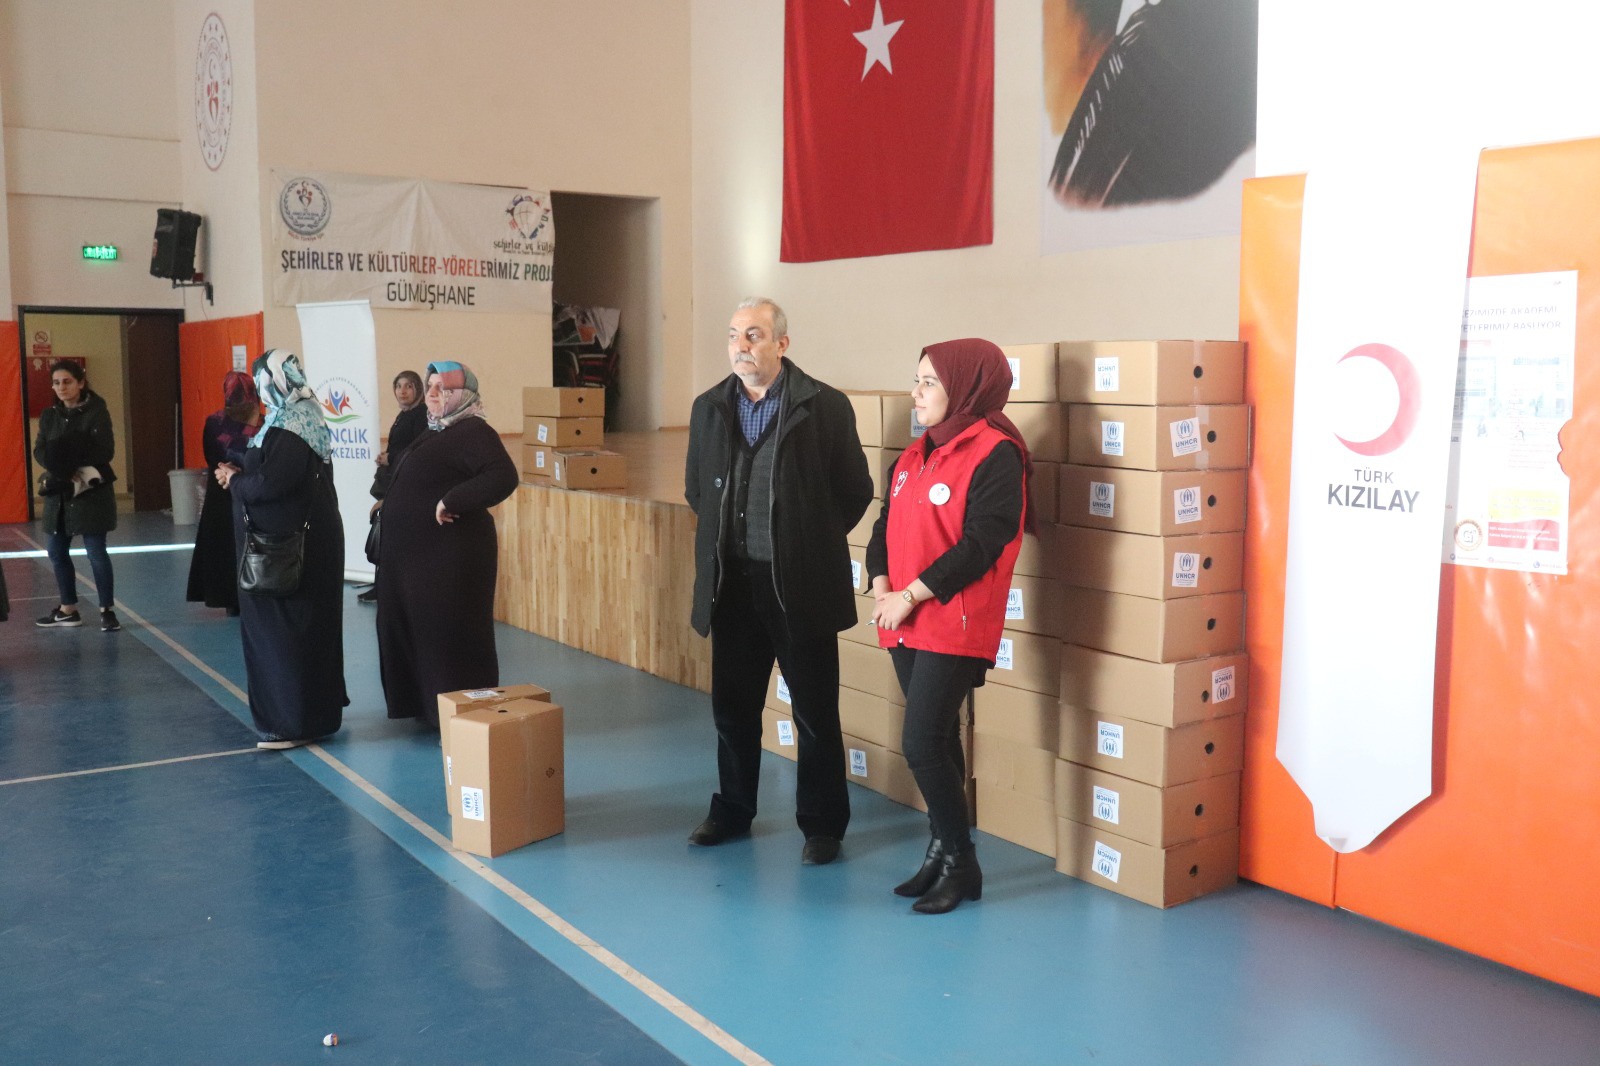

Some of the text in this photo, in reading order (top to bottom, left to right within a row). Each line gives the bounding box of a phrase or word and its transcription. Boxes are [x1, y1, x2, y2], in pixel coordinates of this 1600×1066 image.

[281, 247, 552, 282] ŞEHİRLER VE KÜLTÜRLER-YÖRELERİMİZ PROJ
[387, 279, 476, 310] GÜMÜŞHANE
[329, 426, 369, 445] NÇLİK
[1104, 440, 1121, 448] UNHCR
[1175, 437, 1198, 448] UNHCR
[333, 446, 371, 460] KEZLERİ
[1353, 466, 1395, 484] TÜRK
[1327, 483, 1421, 514] KIZILAY
[1092, 501, 1111, 510] UNHCR
[1177, 506, 1199, 516] UNHCR
[1175, 572, 1196, 580] UNHCR
[1214, 674, 1233, 684] UNHCR
[1100, 728, 1121, 739] UNHCR
[1096, 793, 1116, 805] UNHCR
[1097, 849, 1118, 864] UNHCR
